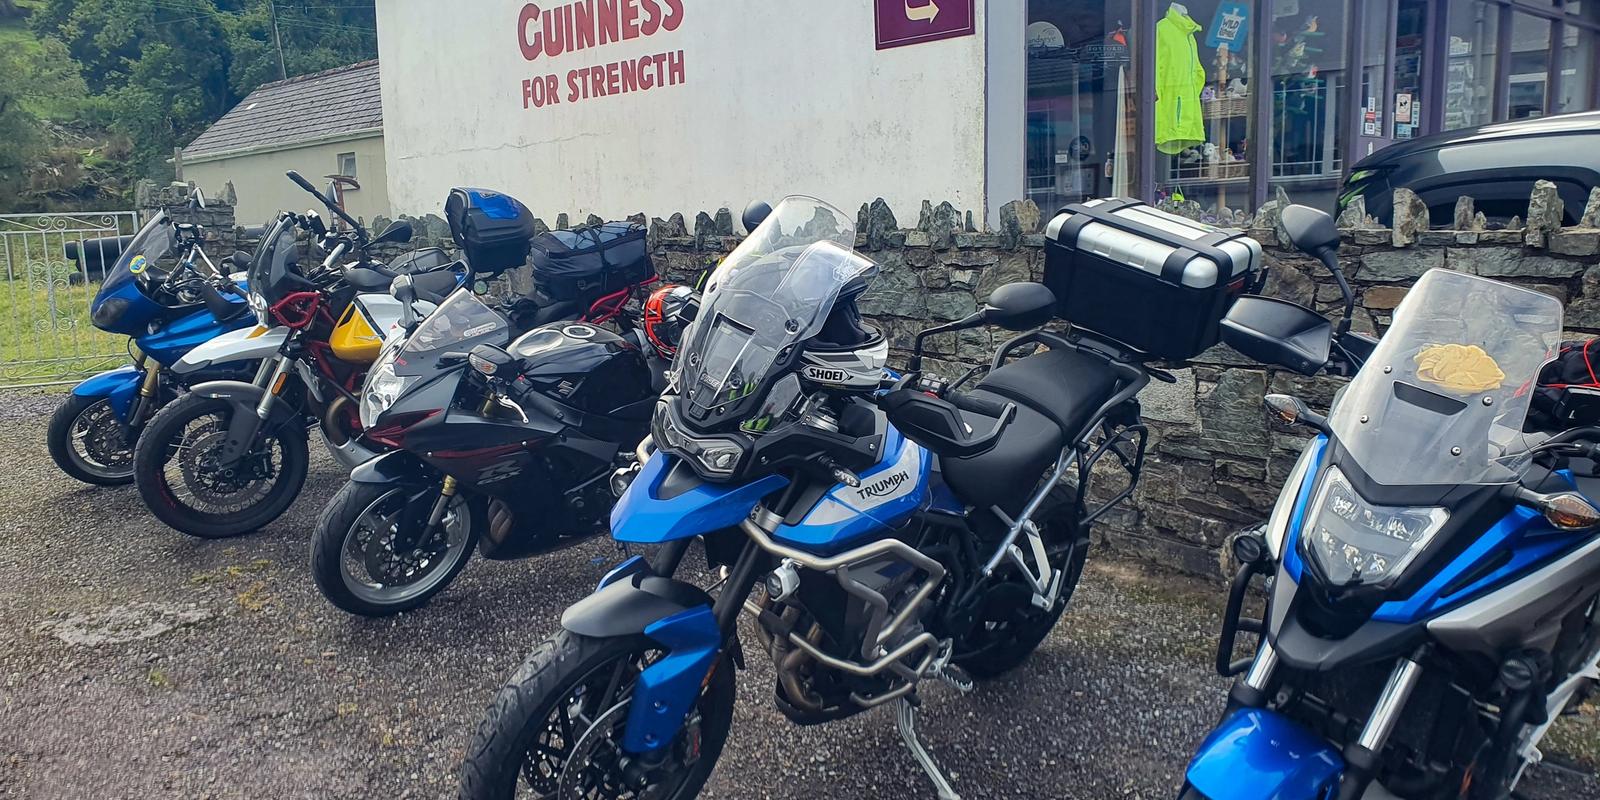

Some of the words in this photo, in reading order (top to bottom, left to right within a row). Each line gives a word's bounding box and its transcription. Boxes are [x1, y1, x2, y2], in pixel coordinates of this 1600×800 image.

[518, 0, 684, 61] GUINNESS
[522, 74, 560, 109] FOR
[567, 50, 685, 102] STRENGTH
[809, 367, 843, 381] SHOEI
[856, 470, 909, 500] TRIUMPH
